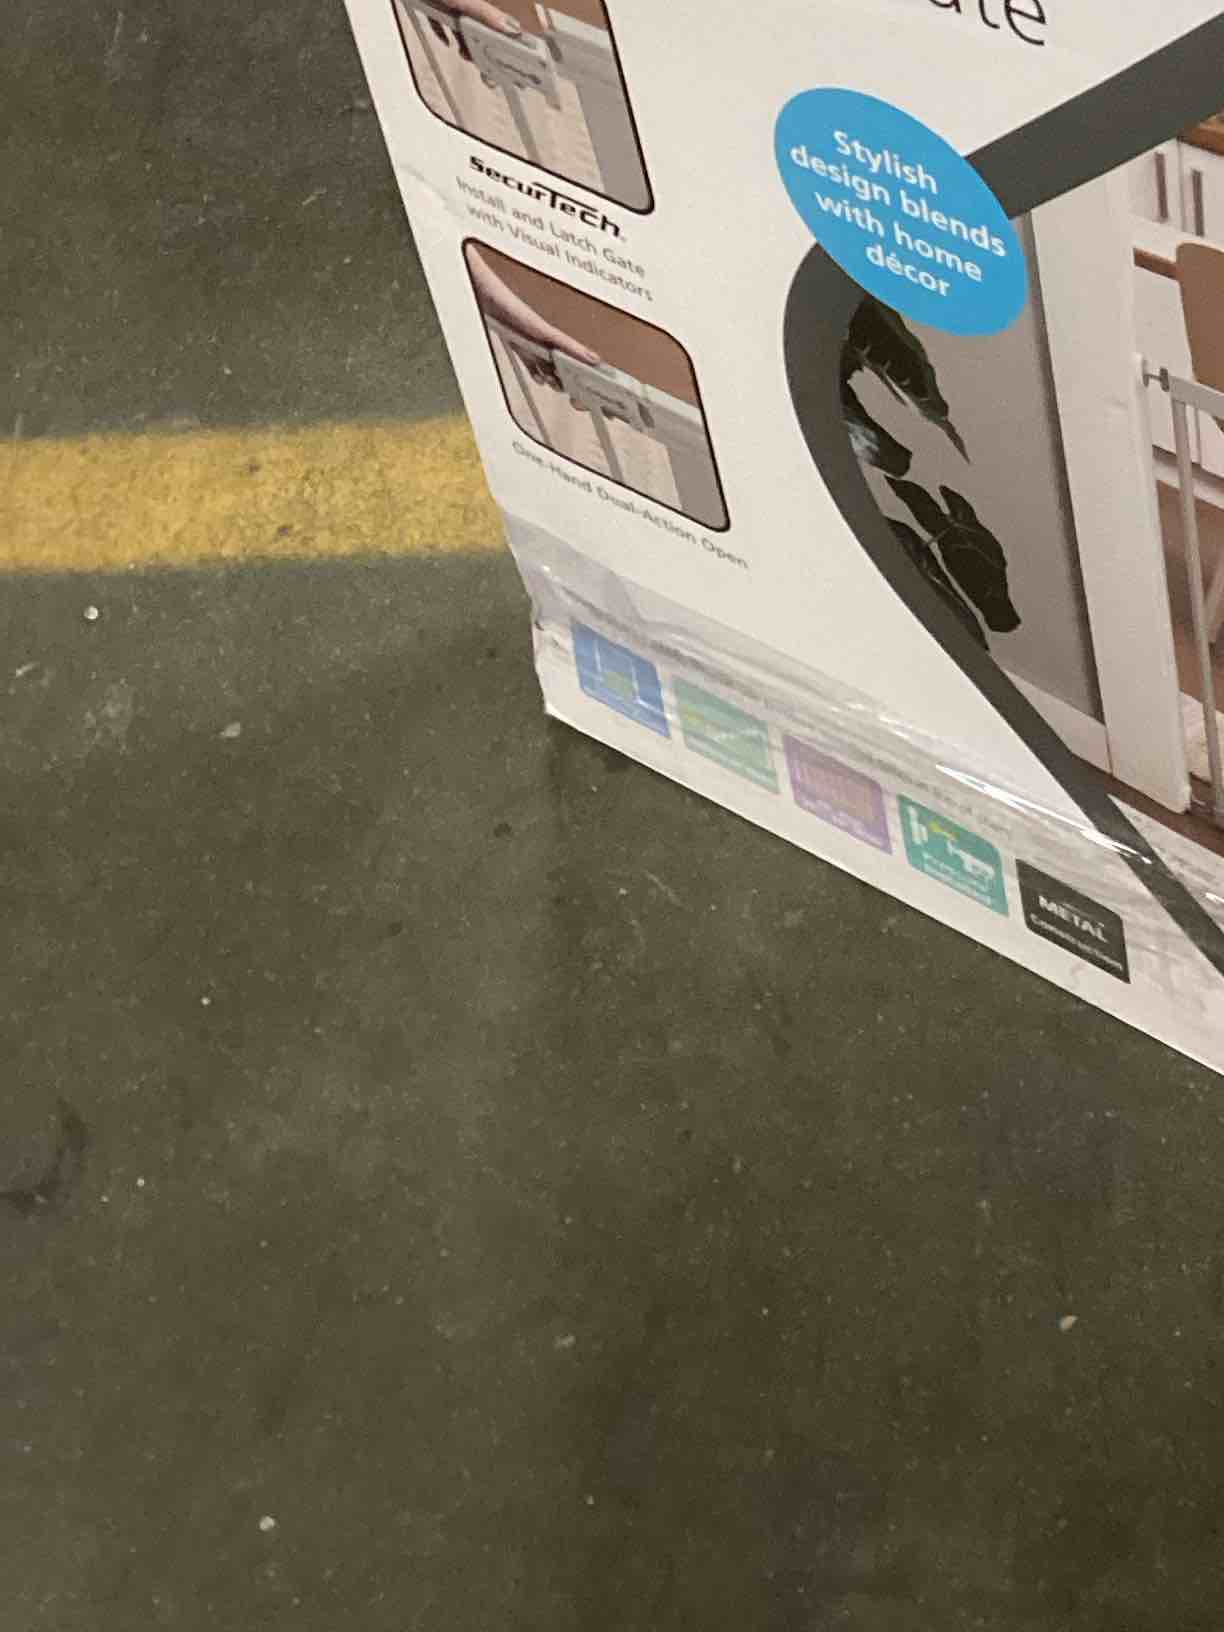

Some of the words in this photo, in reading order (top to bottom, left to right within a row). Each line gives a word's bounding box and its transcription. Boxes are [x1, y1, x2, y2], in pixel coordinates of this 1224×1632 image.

[789, 144, 892, 207] design
[900, 188, 1008, 258] blends
[831, 129, 939, 194] Stylish
[455, 175, 508, 212] Install
[511, 207, 546, 231] and
[549, 221, 600, 255] Latch
[602, 247, 648, 278] Gate
[466, 204, 506, 233] with
[506, 222, 562, 259] Visual
[564, 249, 654, 303] Indicators
[813, 190, 886, 239] with
[893, 220, 985, 283] home
[865, 243, 952, 298] décor
